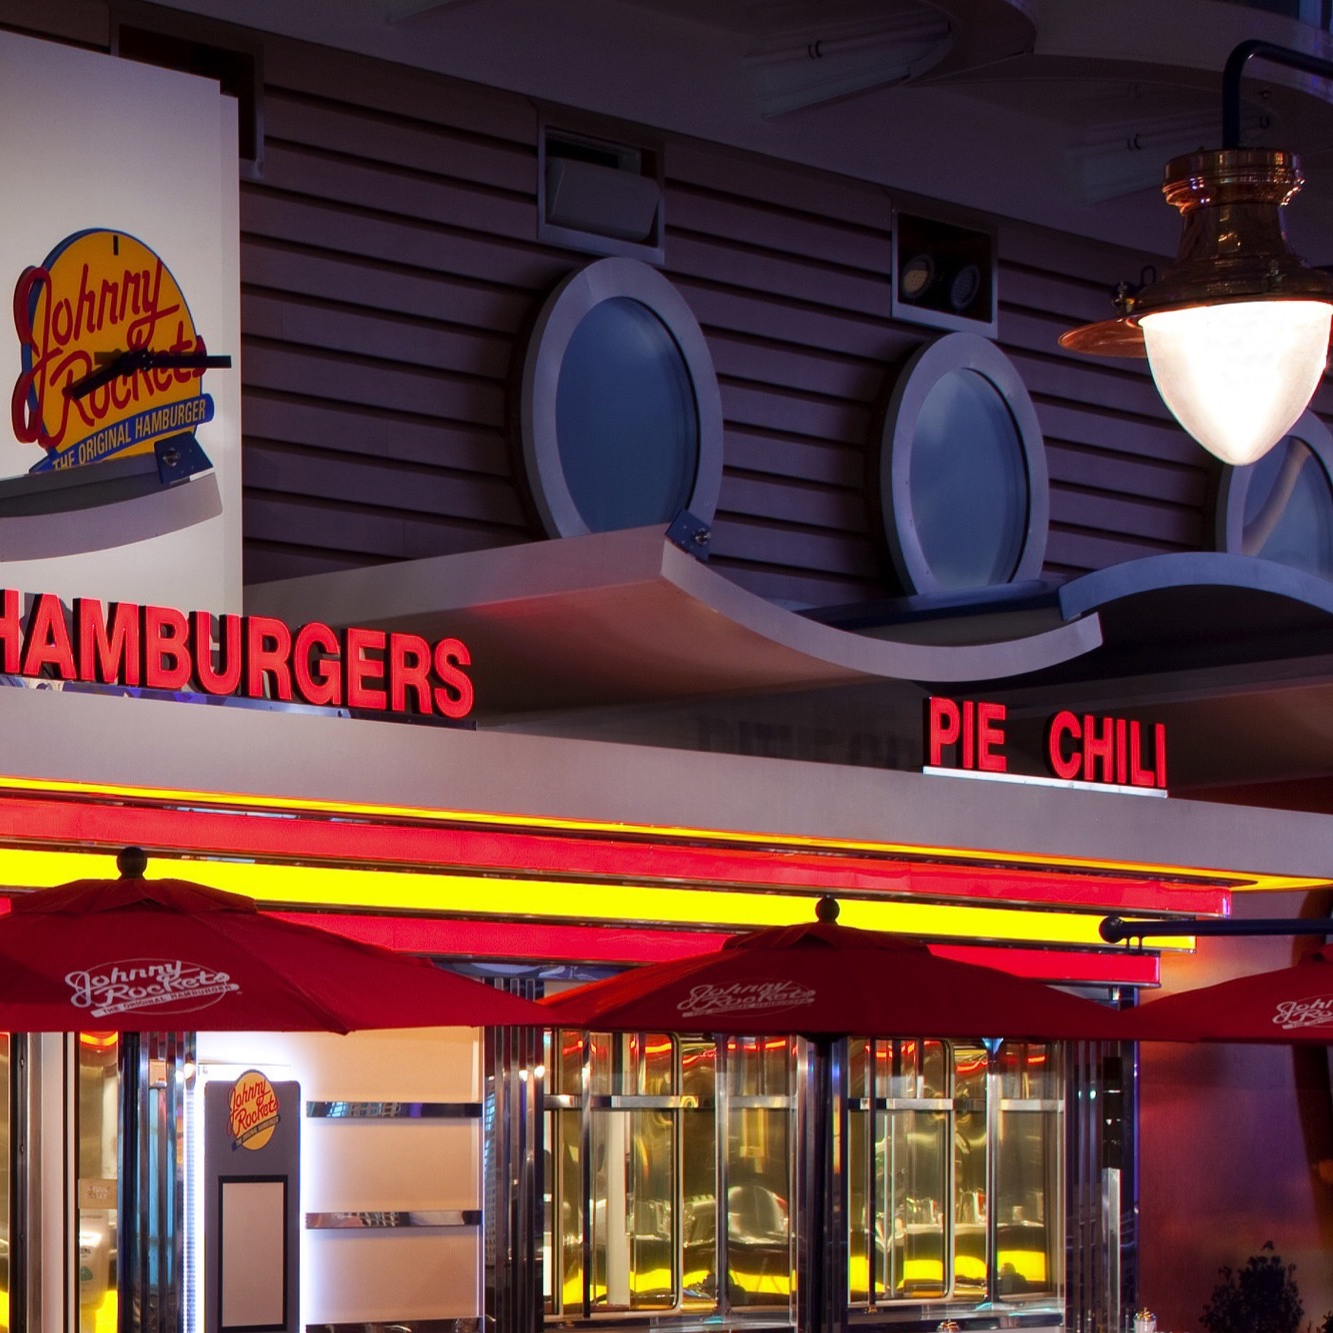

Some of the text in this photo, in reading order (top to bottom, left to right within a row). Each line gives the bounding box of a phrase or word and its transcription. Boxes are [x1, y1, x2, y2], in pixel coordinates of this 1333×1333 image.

[12, 257, 181, 444] Johnny
[78, 424, 132, 466] ORIGINAL
[135, 398, 206, 439] HAMBURGER
[927, 696, 1167, 788] PIE CHILI
[65, 960, 201, 1008] Johnny
[91, 970, 231, 1007] Rockets
[226, 1078, 272, 1137] Johnny
[234, 1093, 280, 1137] Rockets
